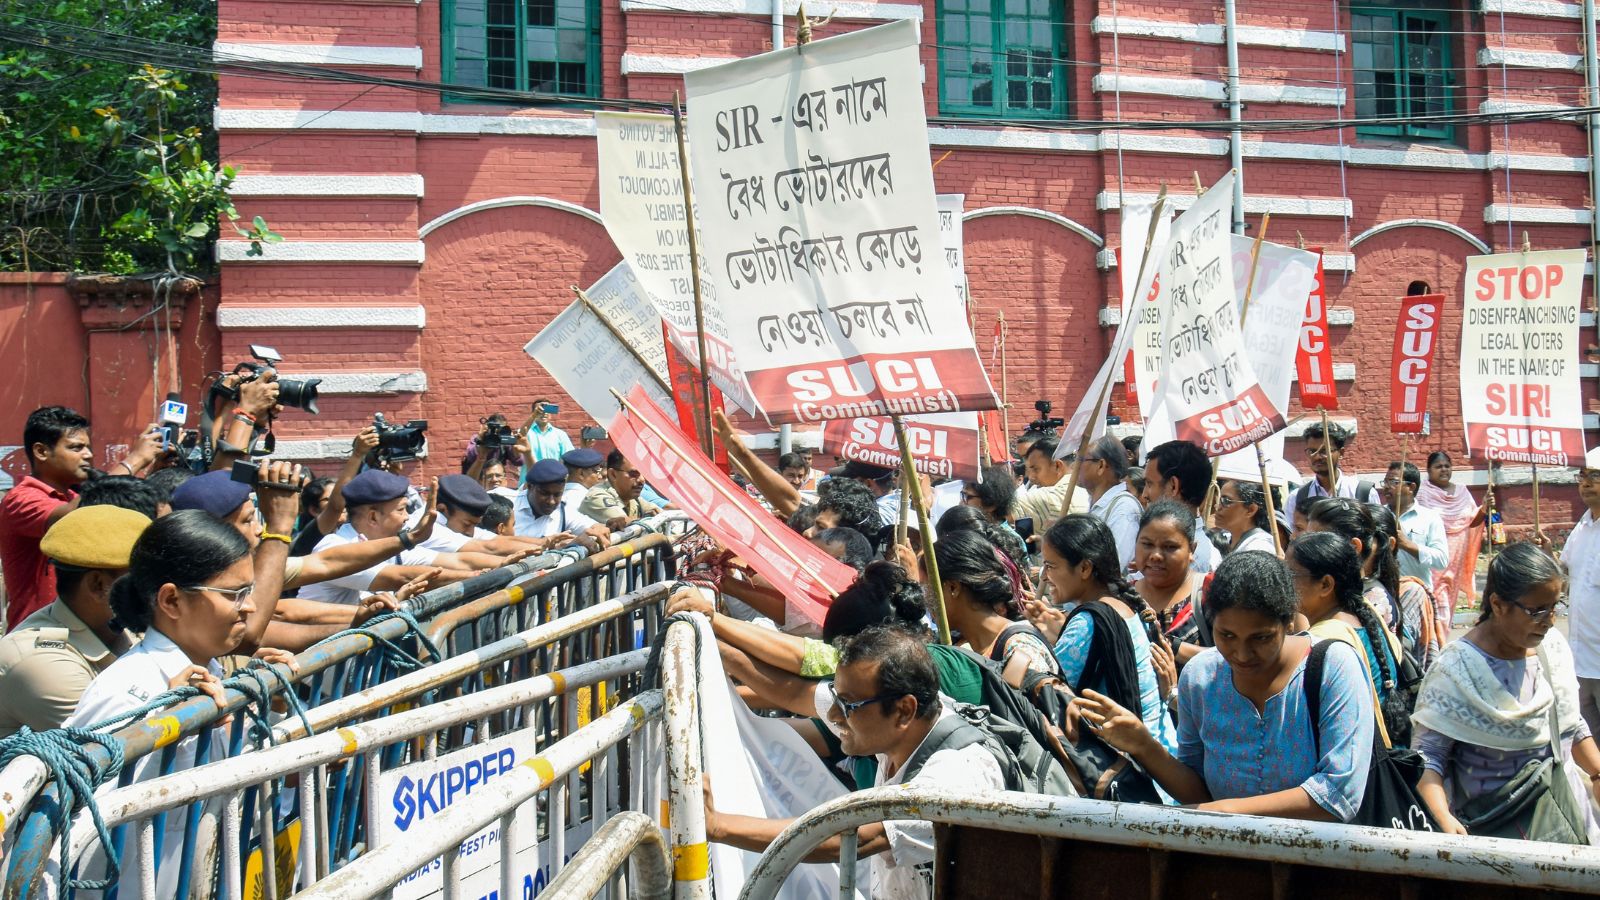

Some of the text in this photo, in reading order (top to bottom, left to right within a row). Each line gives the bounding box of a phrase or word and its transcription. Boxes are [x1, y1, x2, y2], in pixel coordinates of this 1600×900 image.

[715, 104, 764, 152] SIR
[791, 89, 829, 132] এর
[831, 76, 888, 125] নামে
[719, 148, 894, 220] বৈধ ভোটারদের
[725, 225, 922, 290] ভোটাধিকার কেড়ে
[1475, 264, 1564, 301] STOP
[757, 303, 832, 353] নেওয়া
[827, 300, 900, 338] চলবে
[896, 292, 933, 336] না
[1469, 305, 1576, 325] DISENFRANCHISING
[1398, 303, 1436, 413] SUCI
[1480, 331, 1563, 350] LEGAL VOTERS
[786, 357, 944, 401] SUCI
[1478, 358, 1565, 377] IN THE NAME OF
[791, 389, 960, 424] (Communist)
[1200, 395, 1263, 439] SUCI
[1485, 382, 1551, 418] SIR!
[1484, 446, 1568, 467] (Communist)
[1486, 426, 1563, 452] SUCI
[841, 441, 953, 480] (Commnist)
